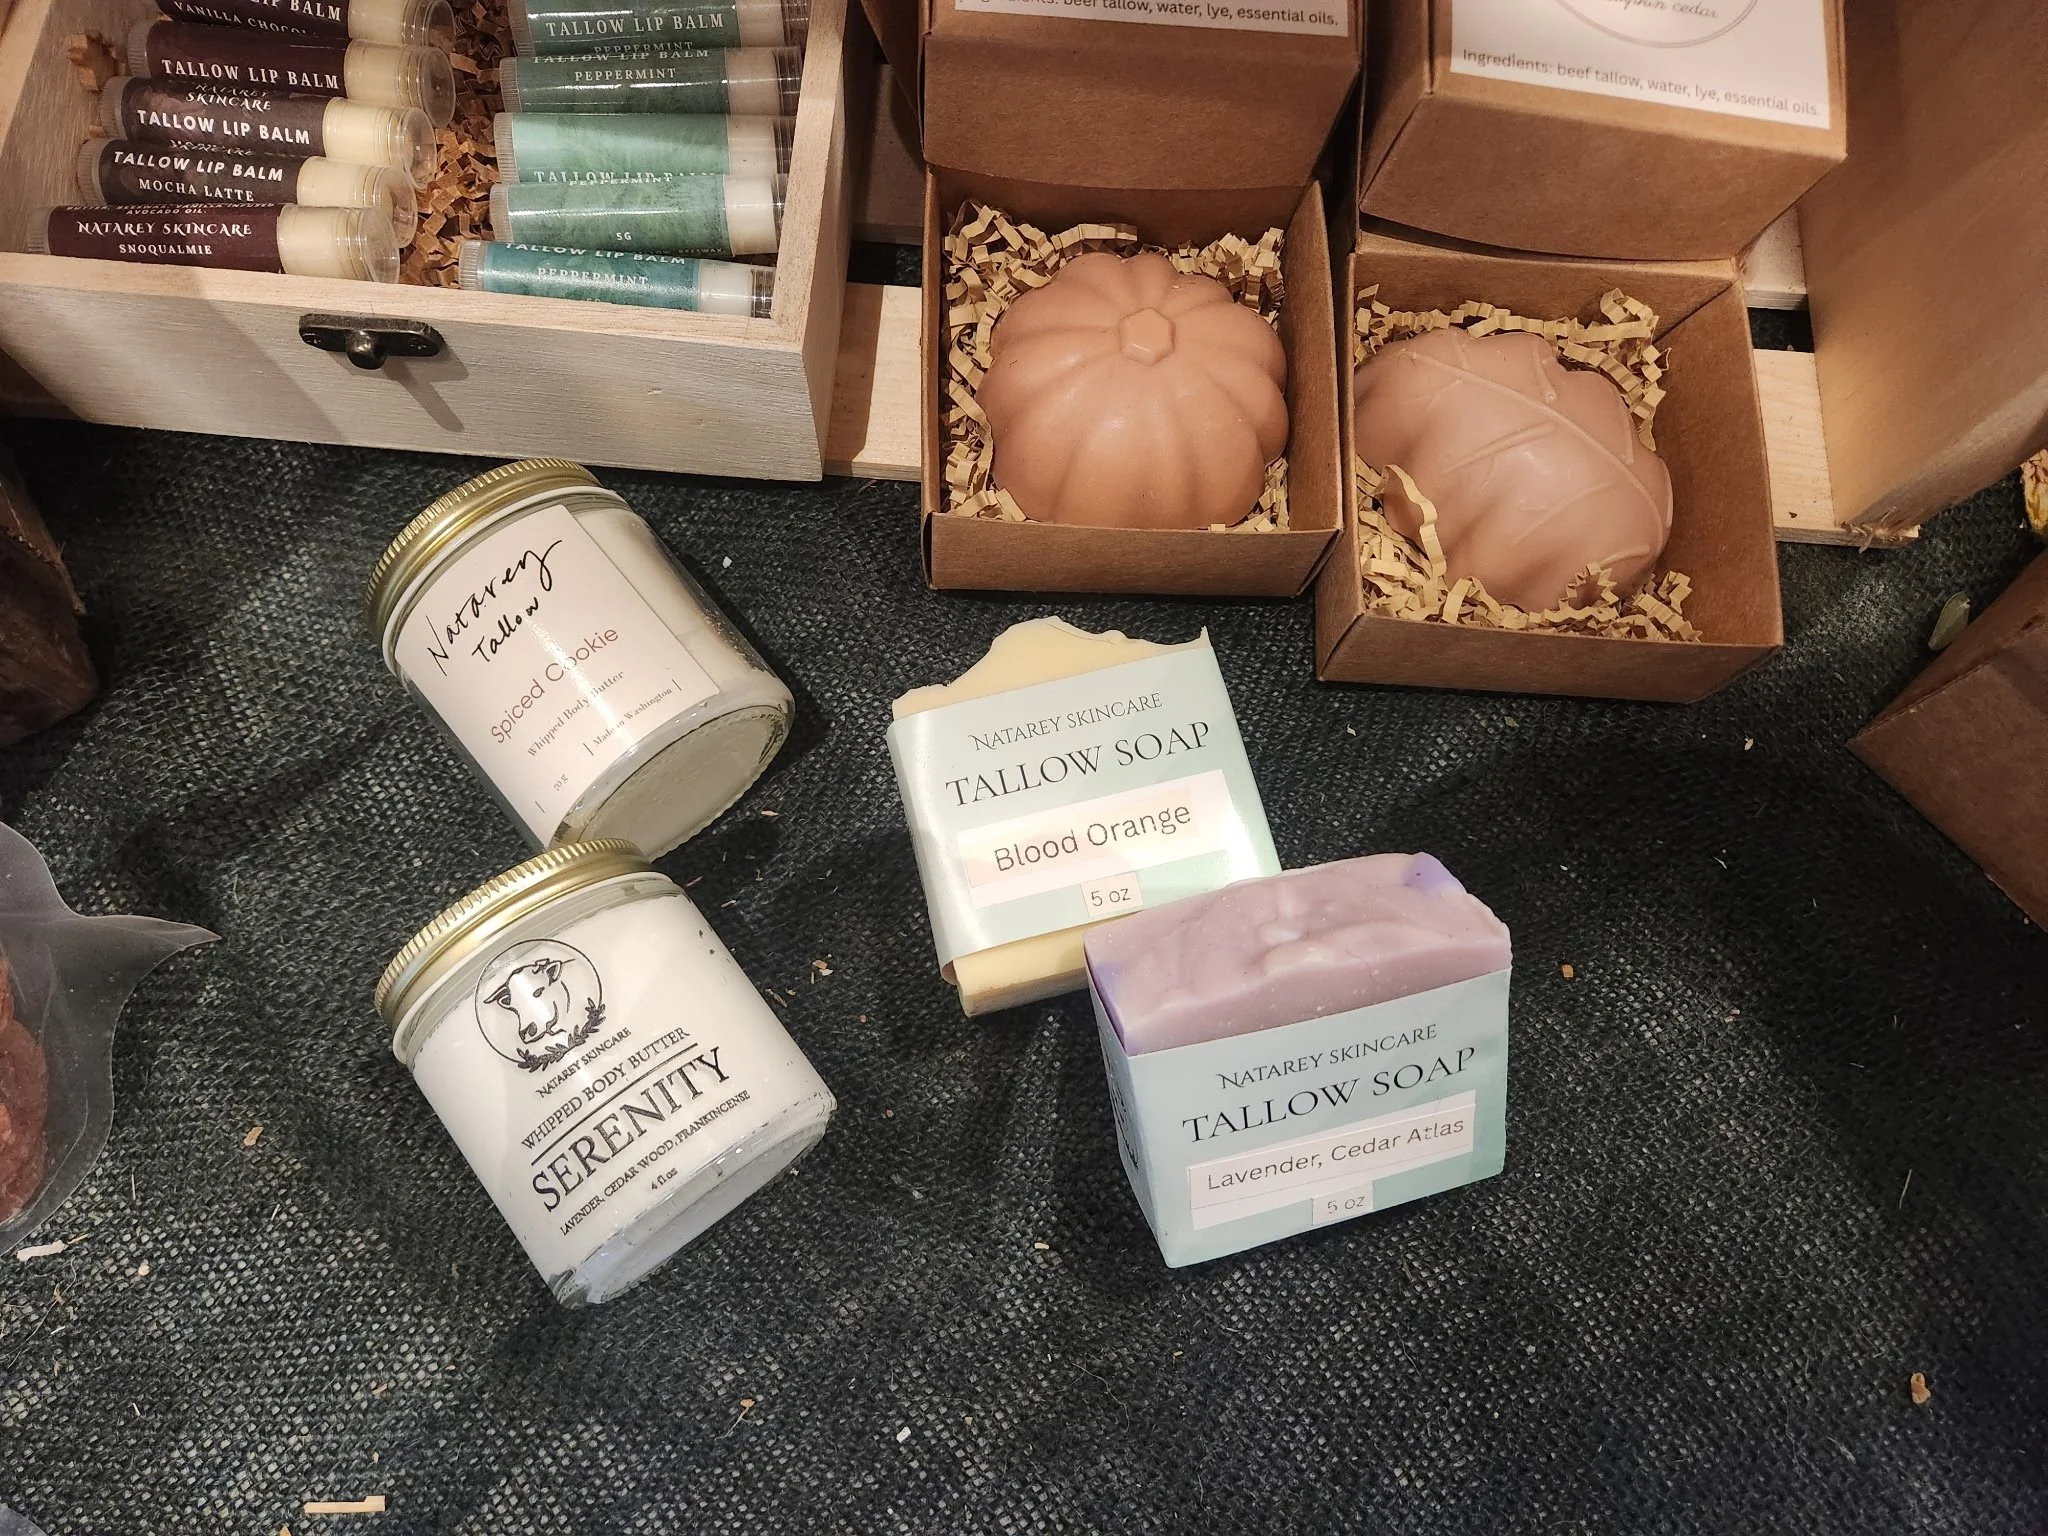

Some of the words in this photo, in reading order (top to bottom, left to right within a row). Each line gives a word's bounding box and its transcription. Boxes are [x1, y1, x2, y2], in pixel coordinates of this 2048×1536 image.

[173, 1, 242, 24] VANILLA
[290, 0, 341, 21] BALM
[1156, 1, 1203, 18] water,
[1206, 4, 1233, 20] lye,
[1237, 5, 1304, 23] essential
[1308, 11, 1339, 27] oils.
[1672, 3, 1719, 19] cedar
[546, 18, 625, 38] TALLOW
[634, 15, 664, 33] LIP
[673, 13, 724, 31] BALM
[533, 54, 610, 64] TALLOW
[620, 52, 650, 61] LIP
[659, 49, 710, 60] BALM
[594, 41, 693, 55] PEPPERMINT
[161, 59, 239, 80] TALLOW
[248, 67, 279, 84] LIP
[286, 70, 341, 90] BALM
[575, 67, 677, 82] PEPPERMINT
[1462, 48, 1552, 75] Ingredients:
[1556, 62, 1593, 79] beef
[1594, 68, 1644, 91] tallow,
[1648, 79, 1691, 98] water,
[1695, 84, 1721, 103] lye,
[1724, 90, 1789, 112] essential
[1792, 101, 1821, 117] oils.
[185, 92, 272, 113] SKINCARE
[137, 109, 215, 134] TALLOW
[222, 119, 251, 137] LIP
[259, 124, 311, 146] BALM
[114, 151, 190, 172] TALLOW
[196, 160, 225, 175] LIP
[232, 163, 284, 183] BALM
[568, 173, 674, 186] PEPPERMINT
[138, 178, 198, 196] MOCHA
[203, 185, 255, 202] LATTE
[126, 208, 180, 216] AVOCADO
[77, 221, 155, 237] NATAREY
[162, 222, 253, 238] SKINCARE
[118, 243, 213, 257] SNOQUALMIE
[505, 242, 587, 256] TALLOW
[595, 250, 626, 259] LIP
[633, 254, 686, 265] BALM
[537, 267, 649, 286] PEPPERMINT
[471, 597, 539, 662] Tallow
[491, 678, 546, 744] Spiced
[545, 629, 619, 682] Cookie
[527, 717, 565, 757] Whipped
[562, 697, 591, 720] Body
[590, 670, 624, 698] Butter
[624, 687, 672, 720] Washington
[968, 715, 1062, 752] NATAREY
[1067, 692, 1163, 730] SKINCARE
[945, 744, 1103, 807] TALLOW
[1114, 721, 1210, 767] SOAP
[993, 828, 1079, 872] Blood
[1087, 805, 1192, 846] Orange
[1090, 890, 1103, 907] 5
[1109, 888, 1131, 903] oz
[535, 1062, 582, 1099] NATAREY
[582, 1026, 632, 1067] SKINCARE
[1216, 1052, 1324, 1090] NATAREY
[1329, 1023, 1438, 1065] SKINCARE
[520, 1096, 584, 1151] WHIPPED
[581, 1061, 628, 1102] BODY
[628, 1026, 691, 1070] BUTTER
[1182, 1078, 1360, 1143] TALLOW
[1371, 1047, 1476, 1097] SOAP
[531, 1046, 731, 1213] SERENITY
[1207, 1152, 1323, 1191] Lavender,
[1331, 1133, 1401, 1162] Cedar
[1406, 1118, 1465, 1144] Atlas
[651, 1179, 659, 1190] 4
[559, 1194, 606, 1237] LAVENDER,
[603, 1166, 640, 1198] CEDAR
[1326, 1199, 1339, 1215] 5
[1344, 1194, 1366, 1211] oz
